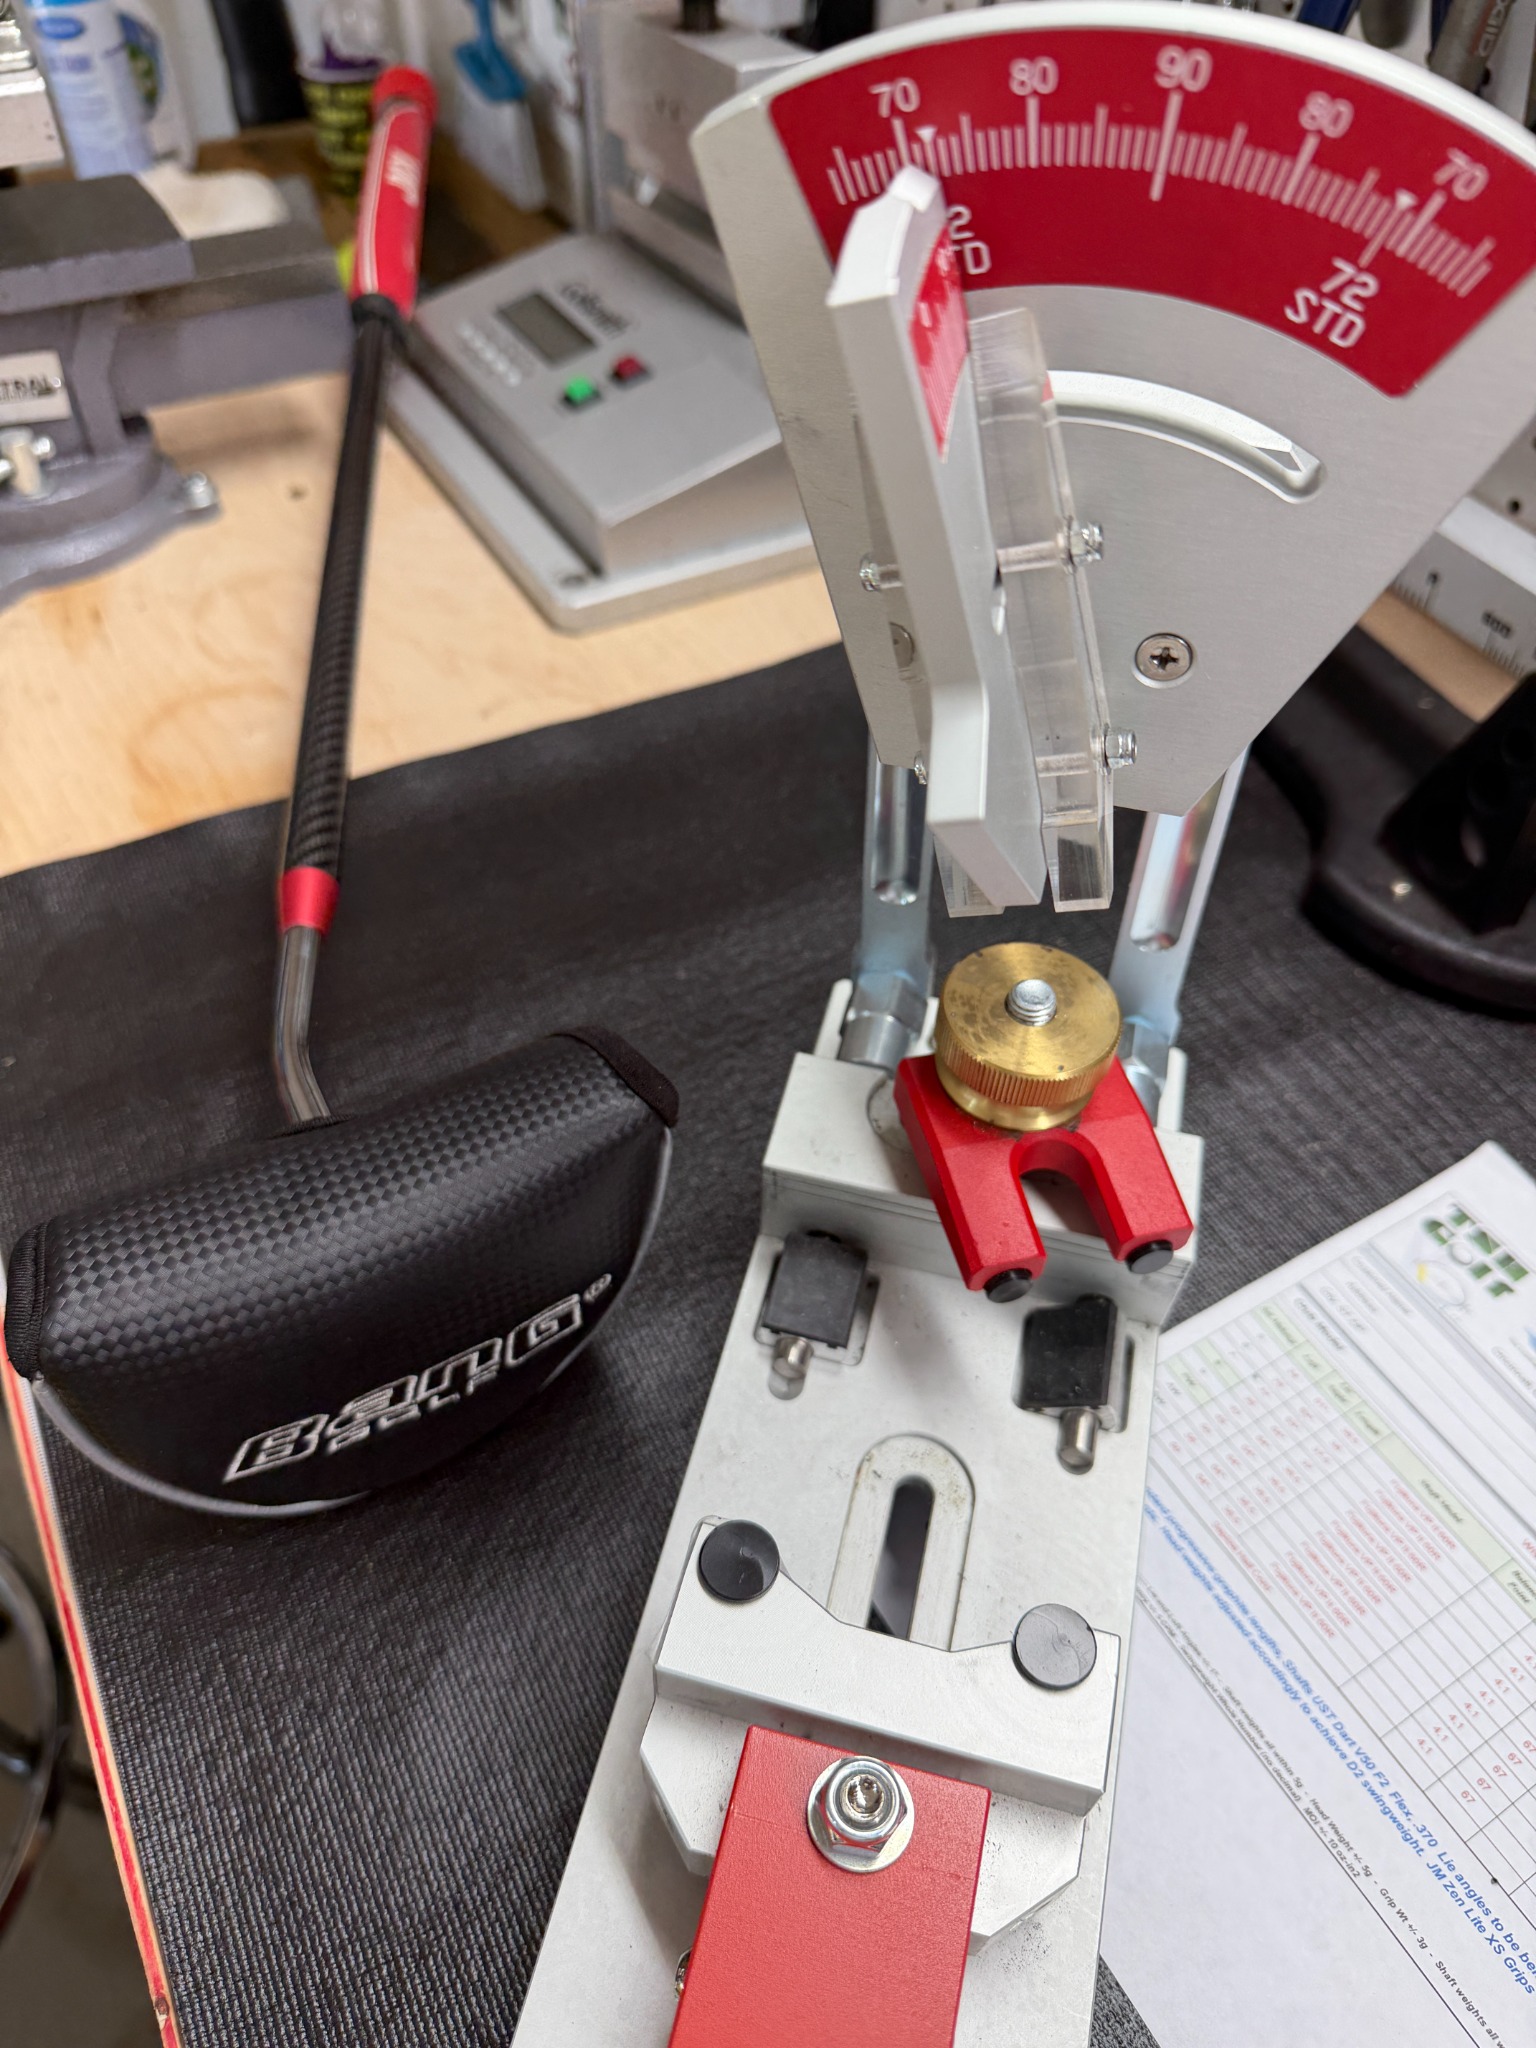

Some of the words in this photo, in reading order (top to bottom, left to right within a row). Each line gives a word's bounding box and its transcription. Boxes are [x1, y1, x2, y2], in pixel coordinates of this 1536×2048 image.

[1008, 57, 1058, 95] 80
[1154, 48, 1213, 92] 90
[870, 78, 920, 117] 70
[1298, 90, 1354, 138] 80
[1433, 150, 1489, 202] 70
[1320, 260, 1380, 313] 72
[1284, 287, 1367, 349] STD
[1494, 1678, 1510, 1694] 4.1
[1509, 1666, 1525, 1682] 4.1
[1464, 1702, 1480, 1718] 4.1
[1479, 1690, 1495, 1706] 4.1
[1433, 1725, 1448, 1742] 4.1
[1449, 1714, 1464, 1730] 4.1
[1417, 1738, 1433, 1754] 4.1
[1507, 1752, 1523, 1766] 67
[1181, 1552, 1213, 1592] weights
[1212, 1593, 1252, 1637] adjusted
[1247, 1638, 1301, 1701] accordingly
[1299, 1702, 1311, 1715] to
[1309, 1716, 1347, 1760] achieve
[1345, 1760, 1364, 1778] D2
[1361, 1779, 1424, 1856] swingweight.
[1426, 1862, 1447, 1880] JM
[1442, 1880, 1465, 1906] Zen
[1463, 1907, 1486, 1933] Lite
[1484, 1933, 1505, 1954] XS
[1503, 1956, 1536, 1993] Grips
[1212, 1571, 1249, 1616] graphite
[1247, 1615, 1281, 1659] lengths,
[1282, 1659, 1312, 1695] Shafts
[1311, 1695, 1337, 1719] UST
[1332, 1721, 1356, 1747] Dart
[1354, 1746, 1376, 1770] V50
[1372, 1771, 1389, 1787] F2
[1388, 1790, 1412, 1821] Flex,
[1412, 1823, 1438, 1847] .370
[1436, 1851, 1455, 1872] Lie
[1454, 1873, 1491, 1916] angles
[1490, 1917, 1503, 1931] to
[1502, 1932, 1519, 1951] be
[1492, 1765, 1508, 1778] 67
[1461, 1790, 1476, 1804] 67
[1476, 1777, 1492, 1791] 67
[1235, 1718, 1262, 1750] Number
[1271, 1766, 1301, 1802] decimal)
[1303, 1807, 1320, 1825] MOI
[1335, 1849, 1360, 1878] oz-in2
[1271, 1746, 1293, 1775] within
[1292, 1776, 1303, 1788] 5g
[1309, 1798, 1330, 1820] Head
[1327, 1820, 1353, 1851] Weight
[1361, 1864, 1372, 1877] 5g
[1379, 1888, 1396, 1908] Grip
[1395, 1908, 1408, 1922] Wt
[1416, 1936, 1428, 1949] 3g
[1435, 1960, 1457, 1987] Shaft
[1455, 1987, 1486, 2027] weights
[1485, 2028, 1499, 2040] all
